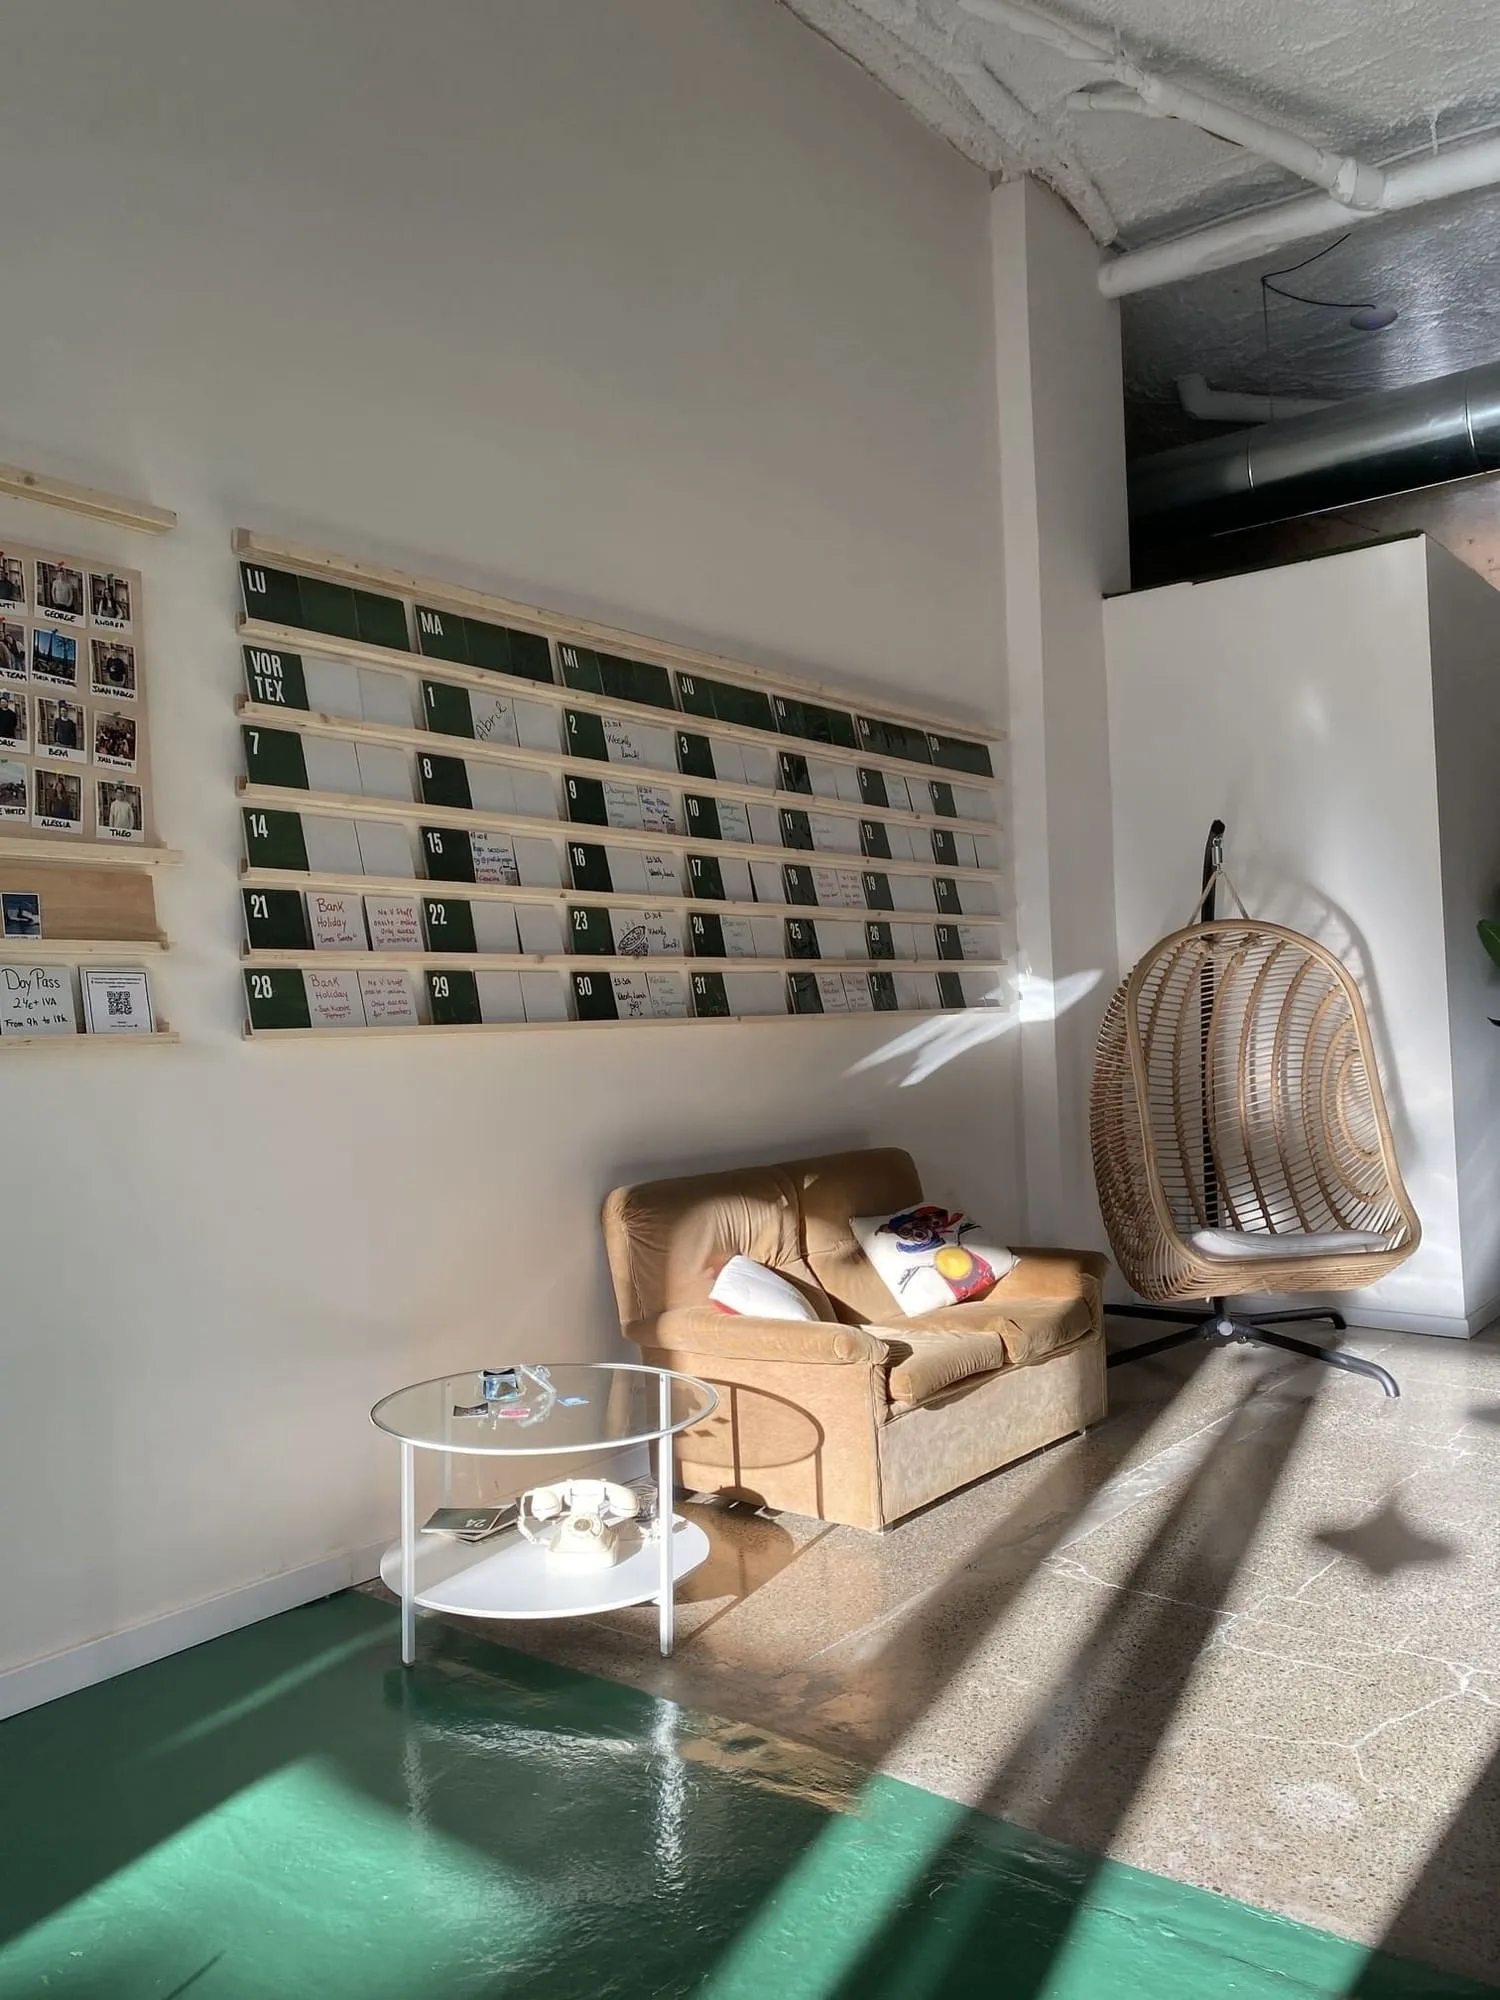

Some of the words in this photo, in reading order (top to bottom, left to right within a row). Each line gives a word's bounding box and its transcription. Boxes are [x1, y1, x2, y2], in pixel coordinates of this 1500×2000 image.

[245, 567, 267, 595] LU
[44, 609, 77, 622] GEORGE
[419, 611, 444, 637] MA
[249, 649, 283, 679] VOR
[562, 647, 579, 669] MI
[253, 677, 286, 704] TEX
[680, 677, 695, 696] JU
[426, 686, 436, 708] 1
[775, 699, 786, 717] VI
[569, 714, 578, 735] 2
[248, 731, 259, 755] 7
[681, 735, 689, 754] 3
[422, 758, 433, 780] 8
[783, 756, 790, 773] 4
[568, 779, 577, 799] 9
[861, 771, 868, 788] 5
[688, 799, 700, 817] 10
[41, 818, 72, 829] ALESSIA
[249, 814, 269, 839] 14
[784, 812, 794, 831] 11
[109, 828, 132, 838] THEO
[864, 824, 875, 840] 12
[426, 832, 444, 855] 15
[572, 847, 586, 867] 16
[691, 859, 702, 877] 17
[866, 875, 876, 891] 19
[250, 894, 270, 920] 21
[316, 897, 345, 913] Bank
[429, 903, 448, 926] 22
[317, 916, 348, 933] Holiday
[573, 910, 588, 931] 23
[693, 916, 705, 935] 24
[790, 922, 802, 939] 25
[870, 925, 880, 941] 26
[939, 928, 948, 943] 27
[1, 968, 31, 997] Day
[29, 967, 61, 990] Pass
[250, 974, 273, 1000] 28
[309, 973, 341, 988] Bank
[432, 975, 450, 999] 29
[576, 976, 593, 996] 30
[694, 976, 707, 995] 31
[790, 976, 798, 993] 1
[872, 975, 879, 992] 2
[41, 997, 58, 1007] IVA
[314, 990, 349, 1002] Holiday
[4, 1019, 24, 1028] From
[26, 1017, 38, 1027] 9h
[42, 1016, 50, 1024] to
[465, 1518, 487, 1528] 24
